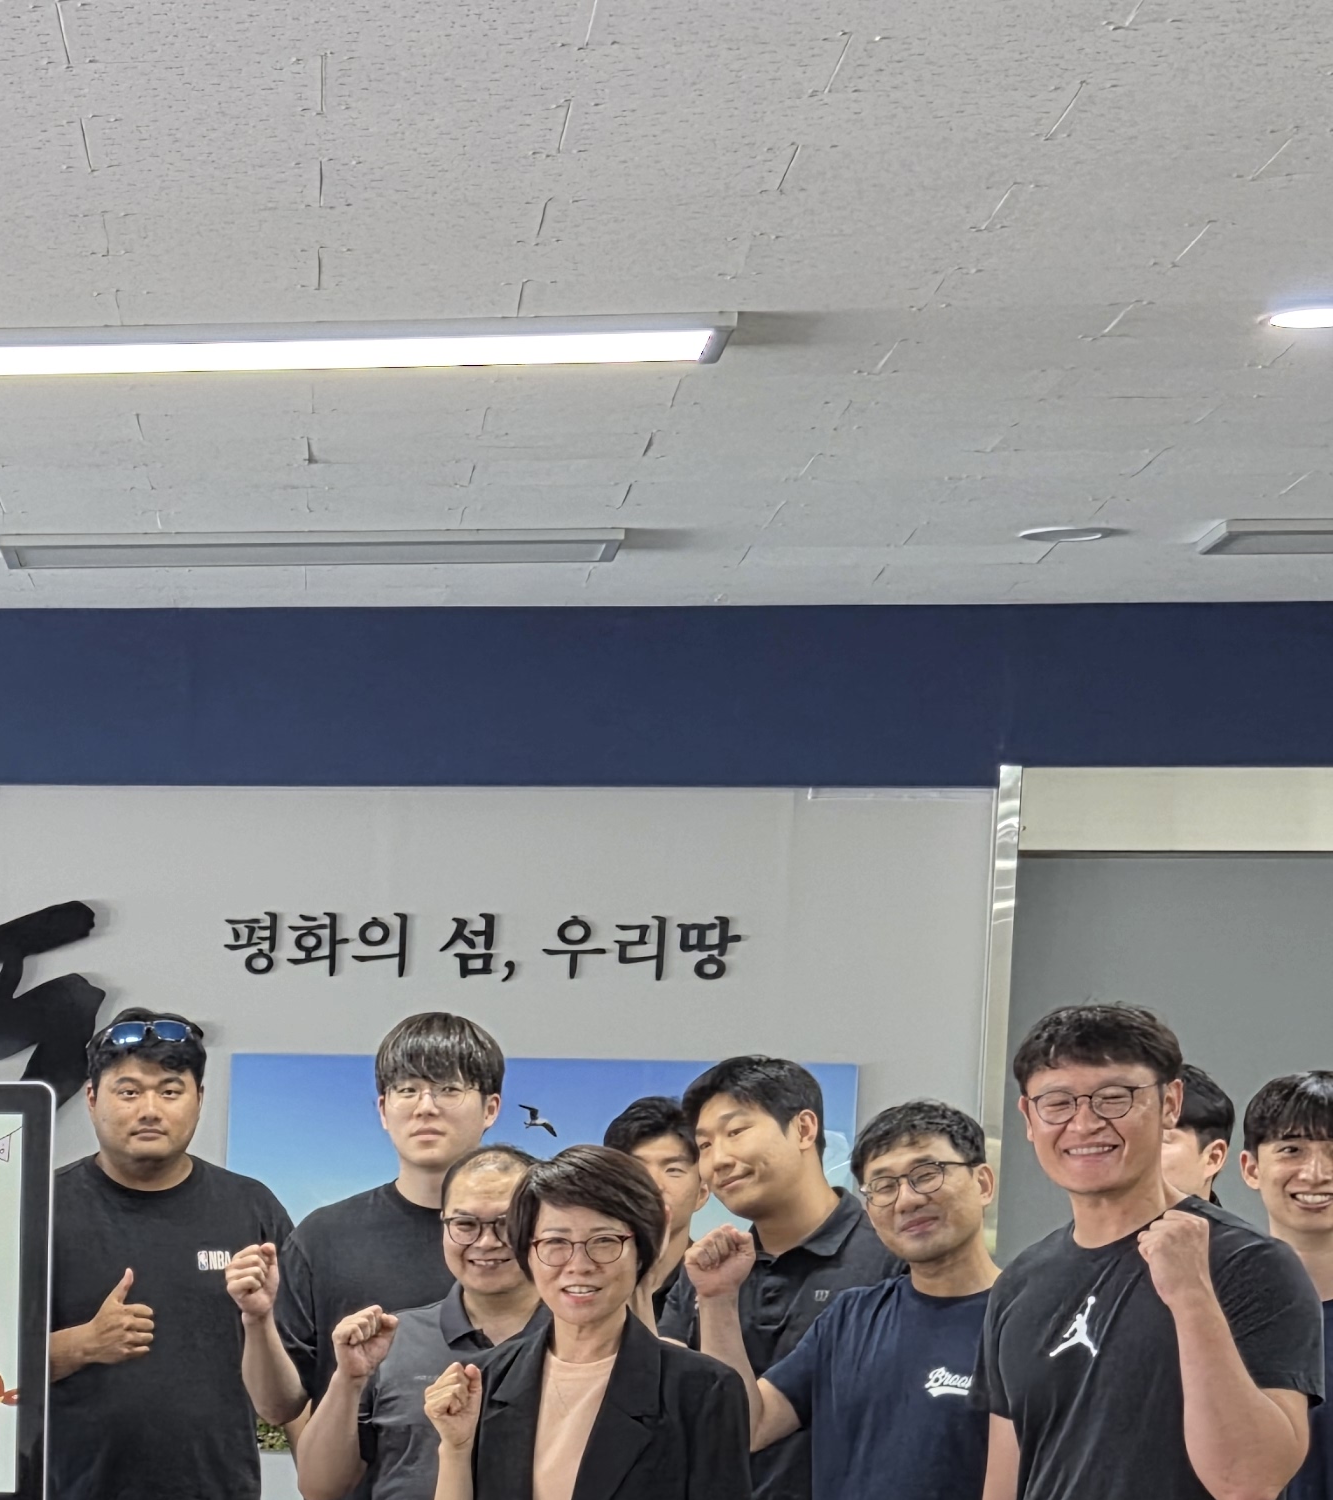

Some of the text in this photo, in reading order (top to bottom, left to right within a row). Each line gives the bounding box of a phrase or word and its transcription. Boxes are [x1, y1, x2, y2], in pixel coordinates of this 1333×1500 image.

[224, 910, 741, 982] 평화의 섬, 우리땅
[208, 1250, 231, 1270] NBA
